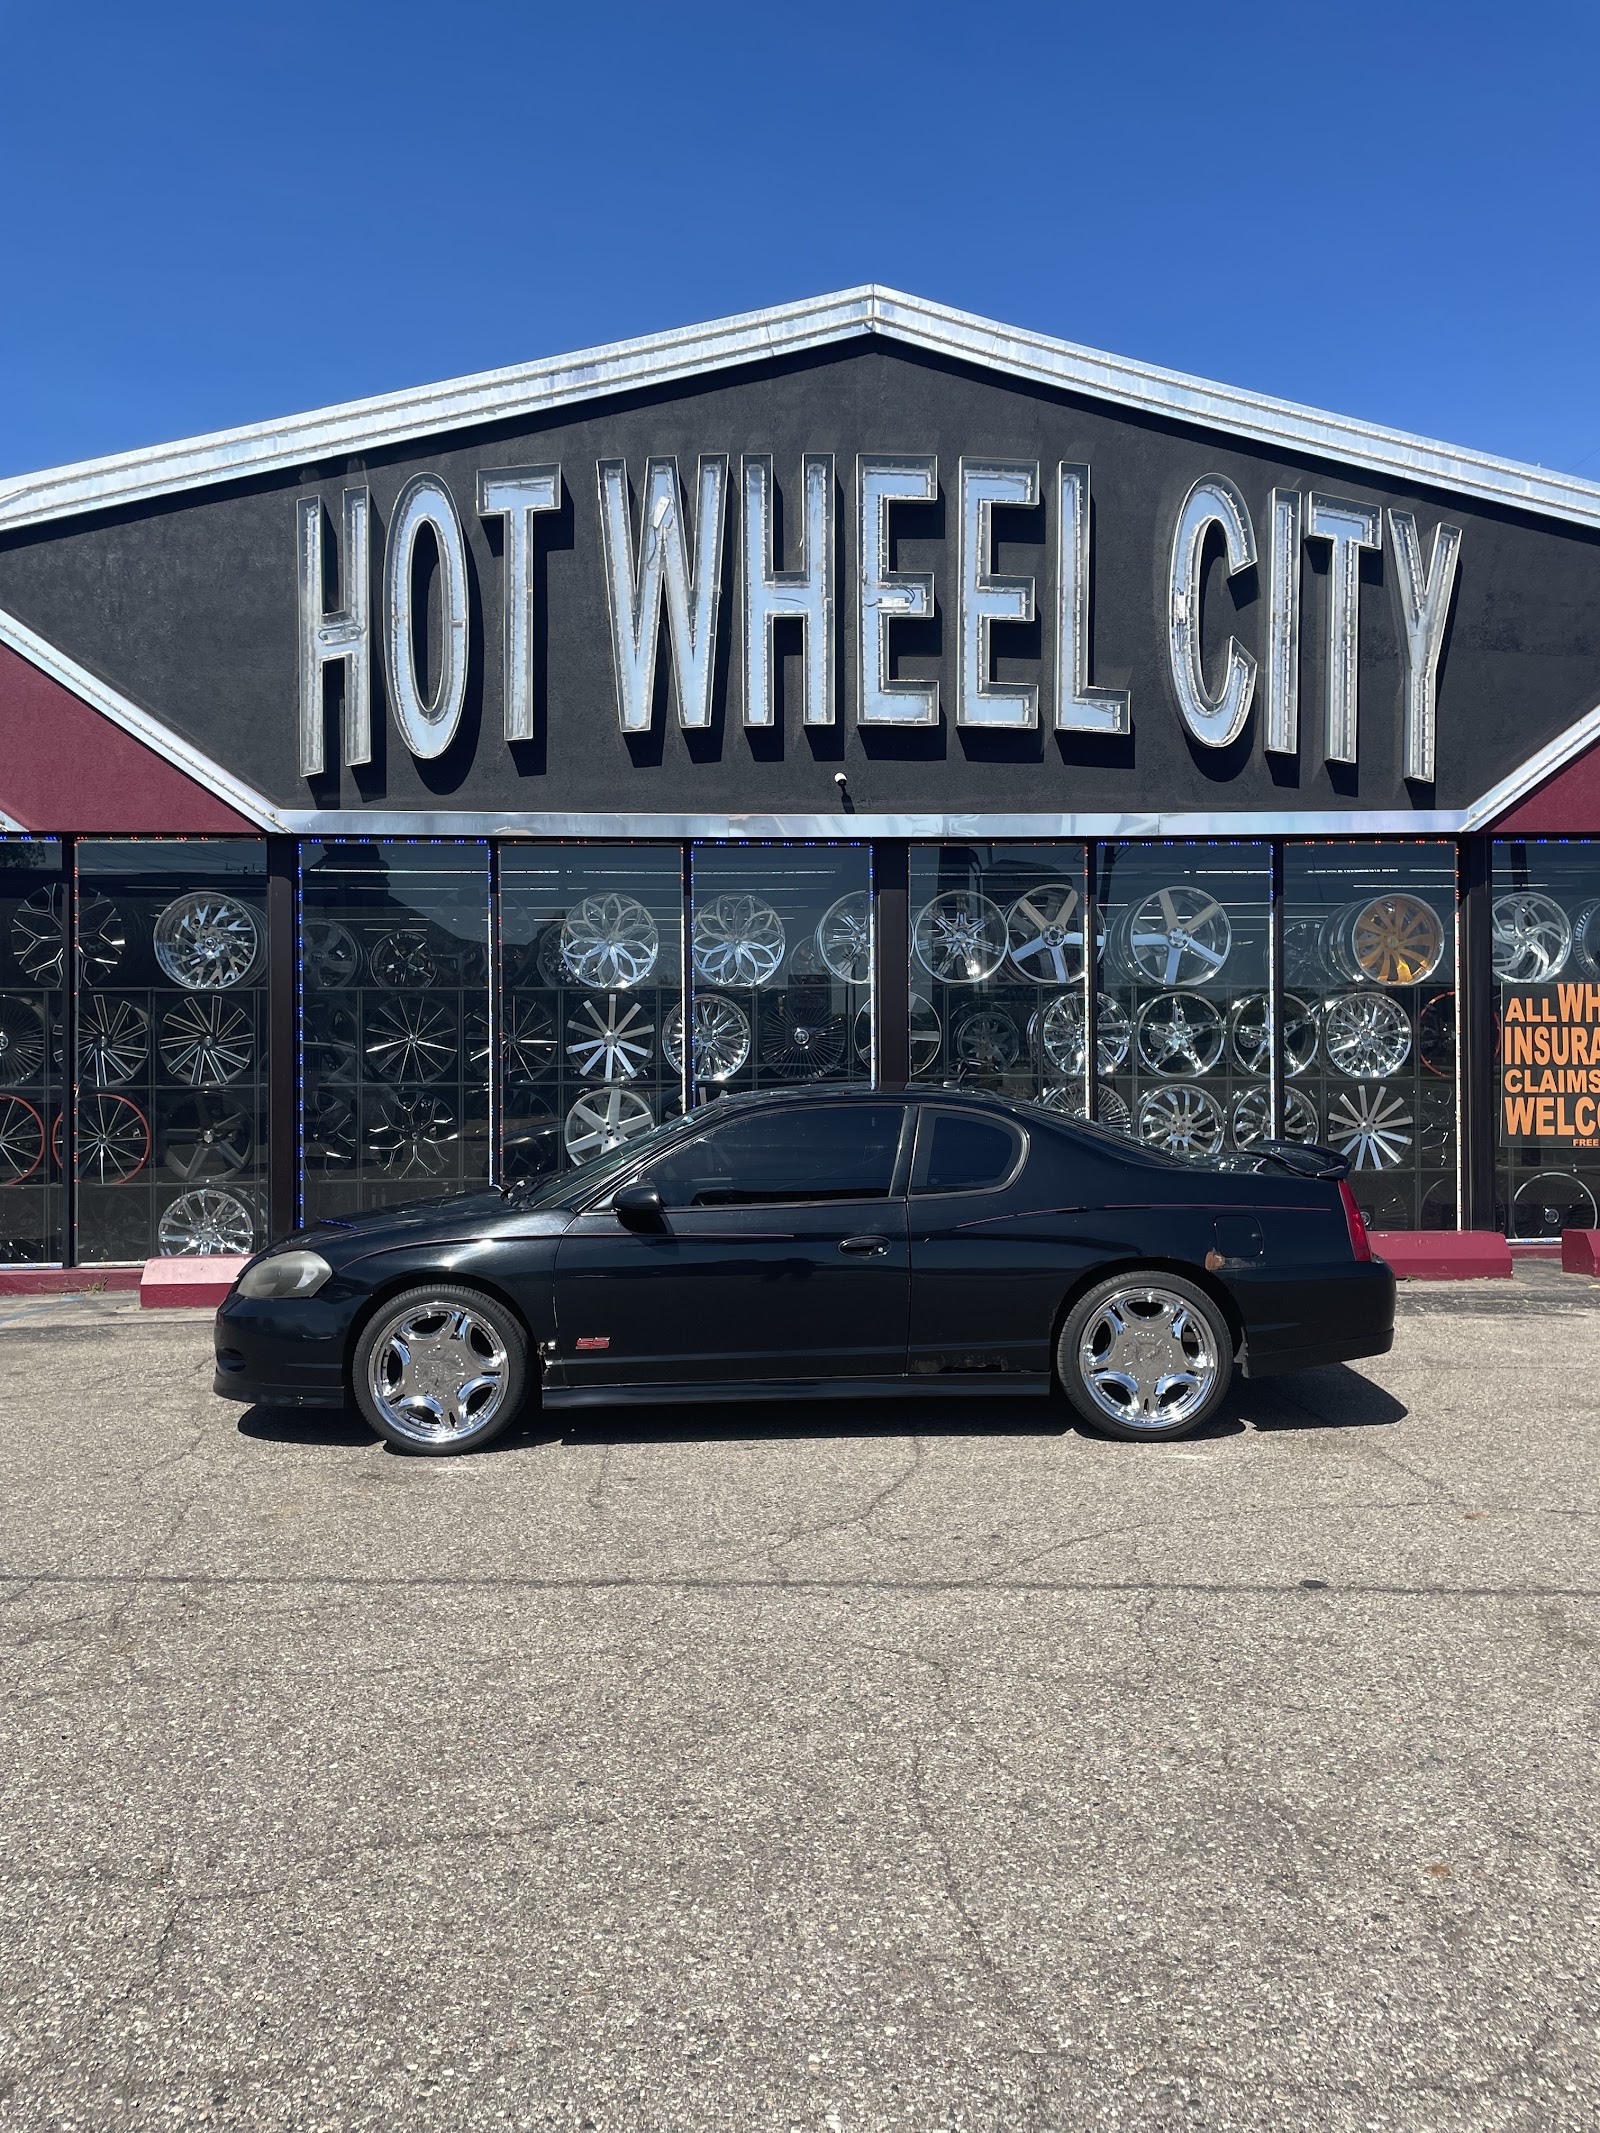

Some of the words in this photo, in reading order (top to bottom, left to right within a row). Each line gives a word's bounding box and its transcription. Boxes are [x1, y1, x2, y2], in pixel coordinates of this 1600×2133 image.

[297, 462, 562, 778] HOT
[596, 452, 1131, 735] WHEEL
[1169, 472, 1463, 784] CITY
[1505, 997, 1558, 1023] ALL
[1504, 1069, 1600, 1093] CLAIMS
[1504, 1096, 1600, 1136] WELC
[1573, 1138, 1599, 1147] FREE
[575, 1336, 611, 1350] SS
